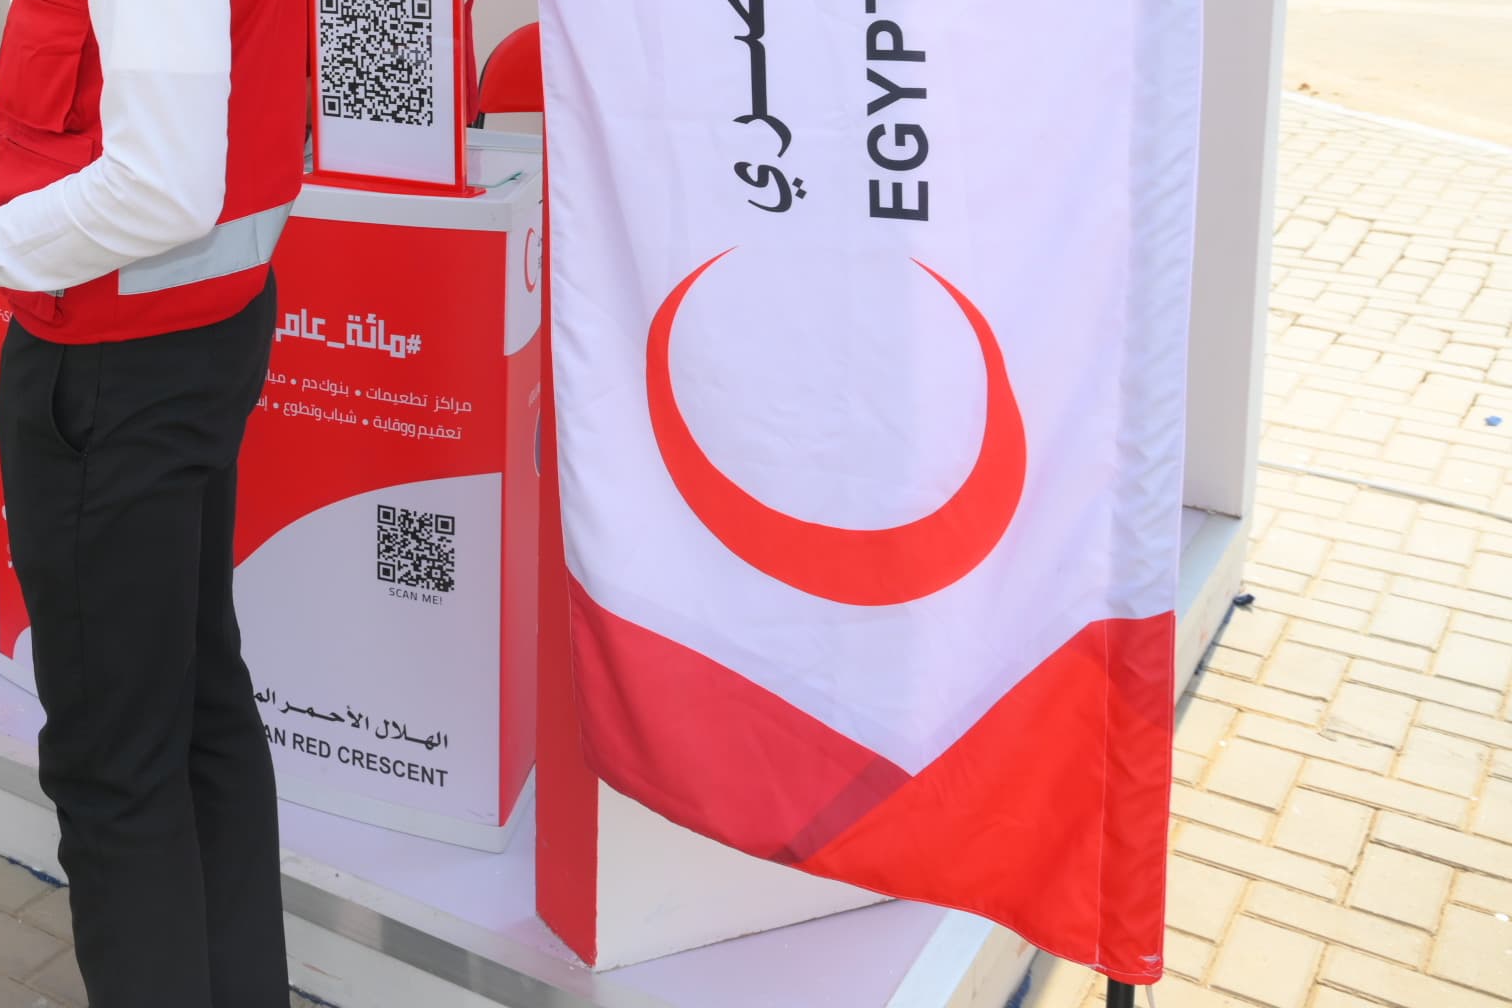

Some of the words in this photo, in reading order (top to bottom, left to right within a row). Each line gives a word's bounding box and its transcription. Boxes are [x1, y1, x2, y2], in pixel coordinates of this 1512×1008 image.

[365, 387, 429, 408] تطعيمات
[433, 395, 473, 416] مراكز
[417, 424, 462, 441] تعقيم
[388, 587, 418, 602] SCAN
[421, 593, 443, 606] ME!
[278, 701, 370, 730] الأحمر
[374, 718, 448, 751] الهلال
[292, 732, 332, 758] RED
[337, 746, 448, 787] CRESCENT
